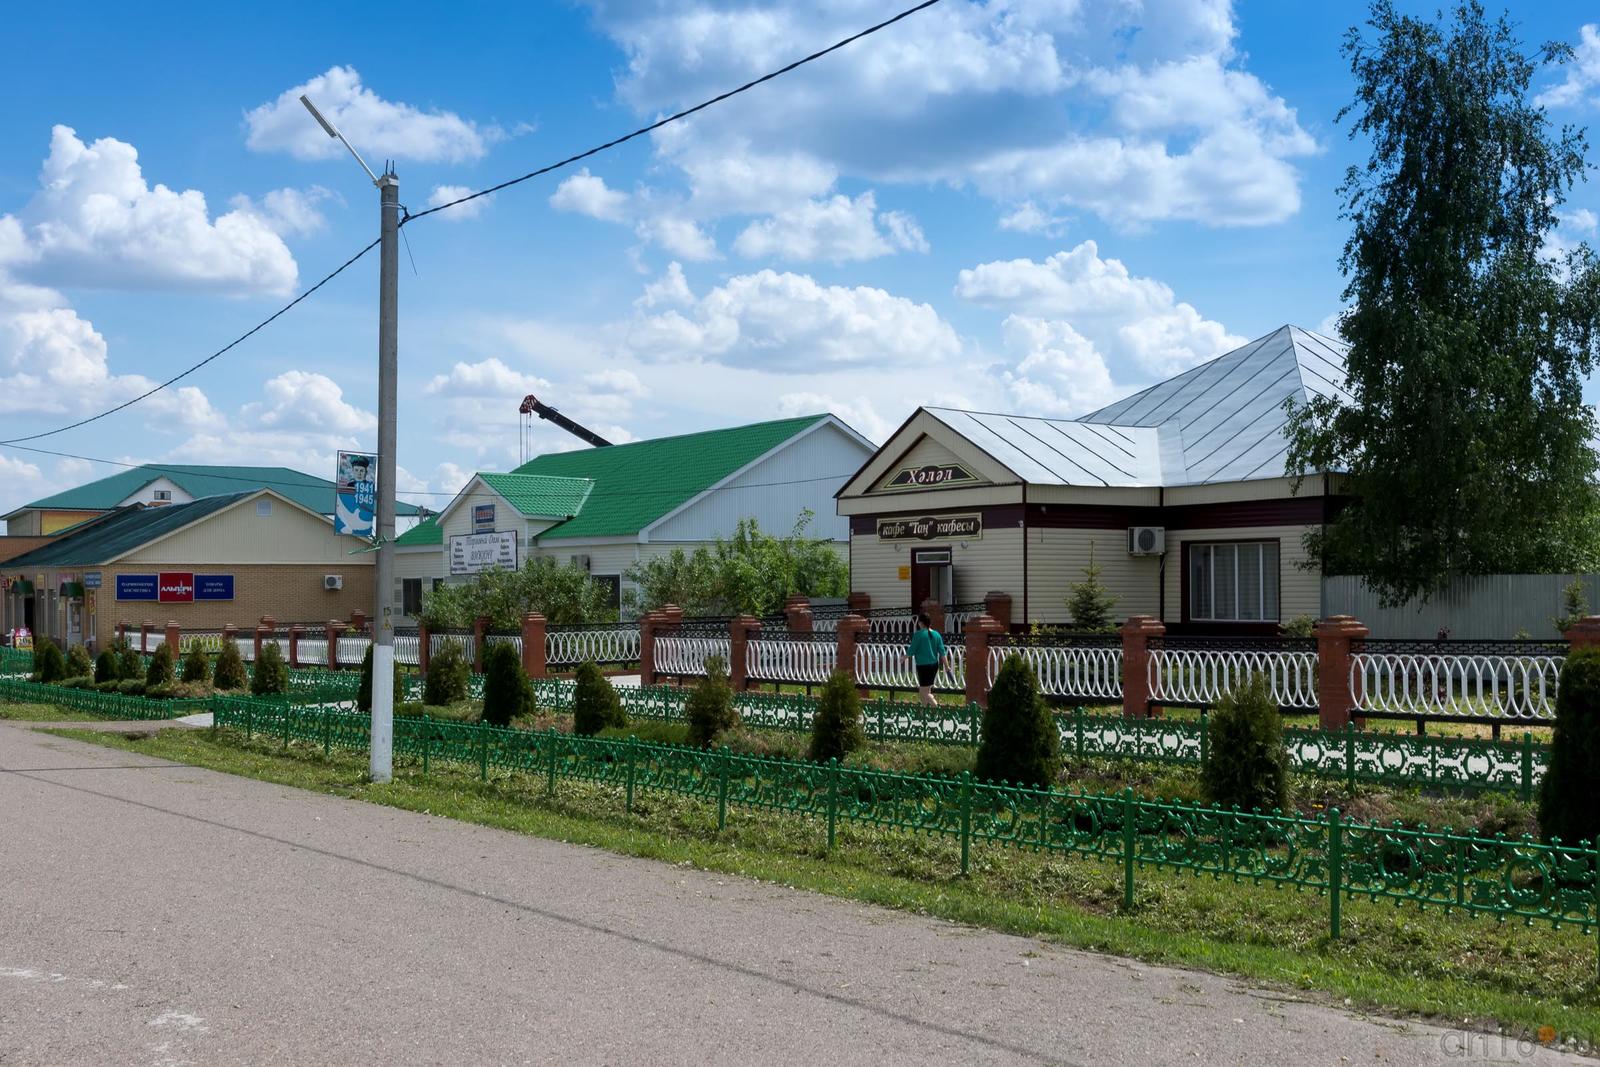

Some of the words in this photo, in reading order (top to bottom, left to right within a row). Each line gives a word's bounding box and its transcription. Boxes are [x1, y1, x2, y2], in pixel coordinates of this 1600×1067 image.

[907, 469, 953, 484] Хәләл
[355, 482, 374, 494] 1941
[354, 493, 374, 505] 1945
[882, 522, 905, 538] кафе
[936, 519, 974, 535] кафесы
